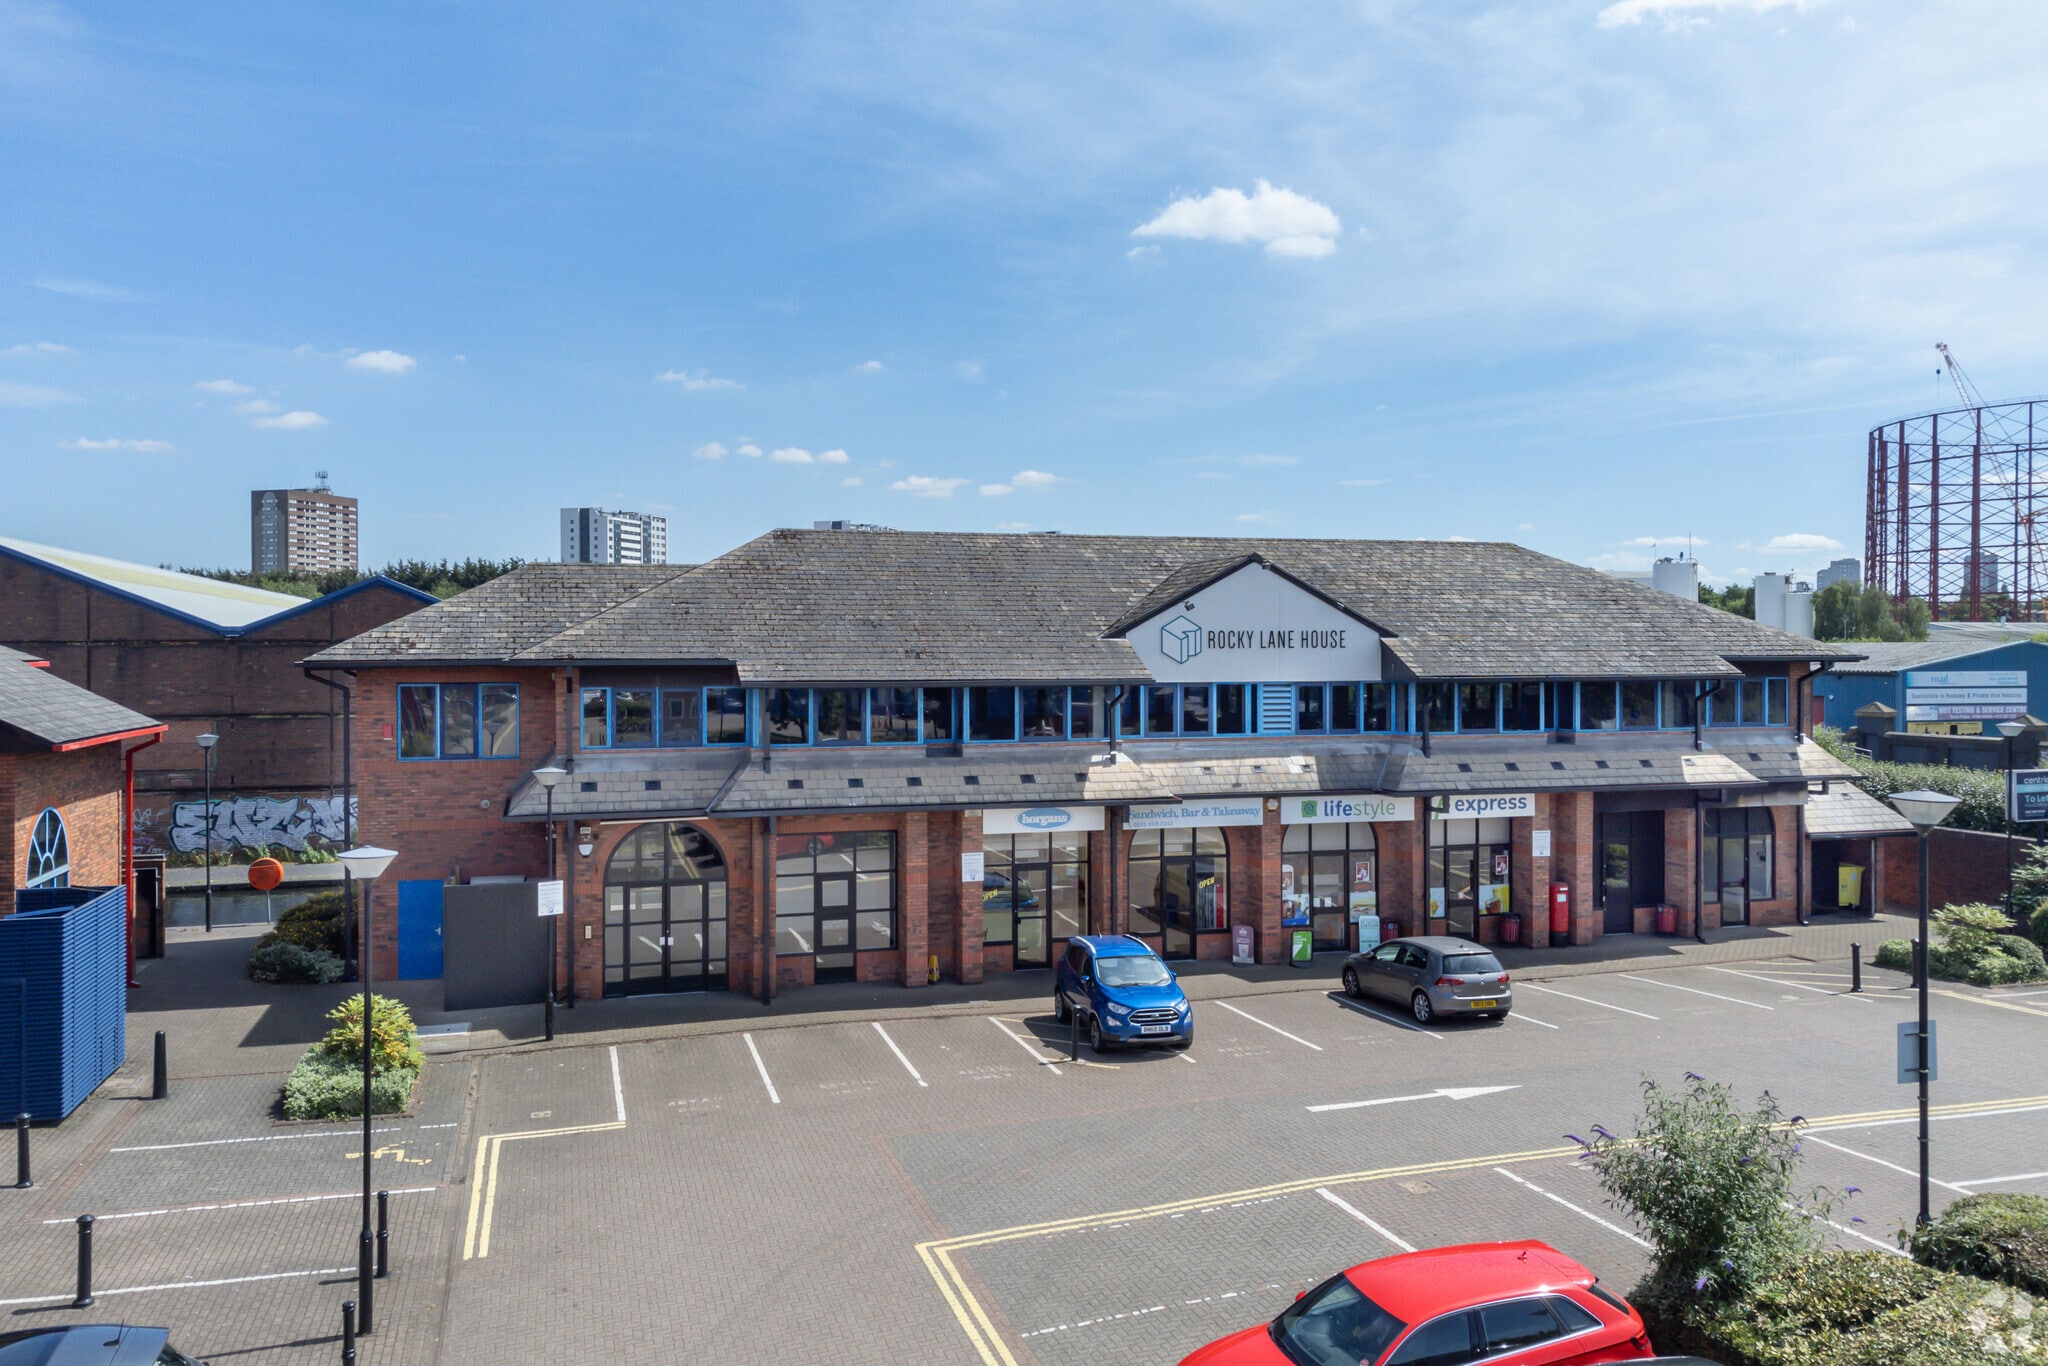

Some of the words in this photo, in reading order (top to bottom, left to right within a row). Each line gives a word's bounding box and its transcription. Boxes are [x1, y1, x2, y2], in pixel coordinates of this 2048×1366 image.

[1208, 630, 1252, 649] ROCKY
[1260, 630, 1294, 649] LANE
[1301, 629, 1346, 648] HOUSE
[1454, 796, 1527, 814] express
[2025, 795, 2035, 803] To
[1181, 808, 1199, 818] Bar
[1201, 807, 1210, 817] &
[1211, 806, 1261, 818] Takeaway
[1324, 800, 1395, 819] lifestyle
[1199, 876, 1215, 889] OPEN
